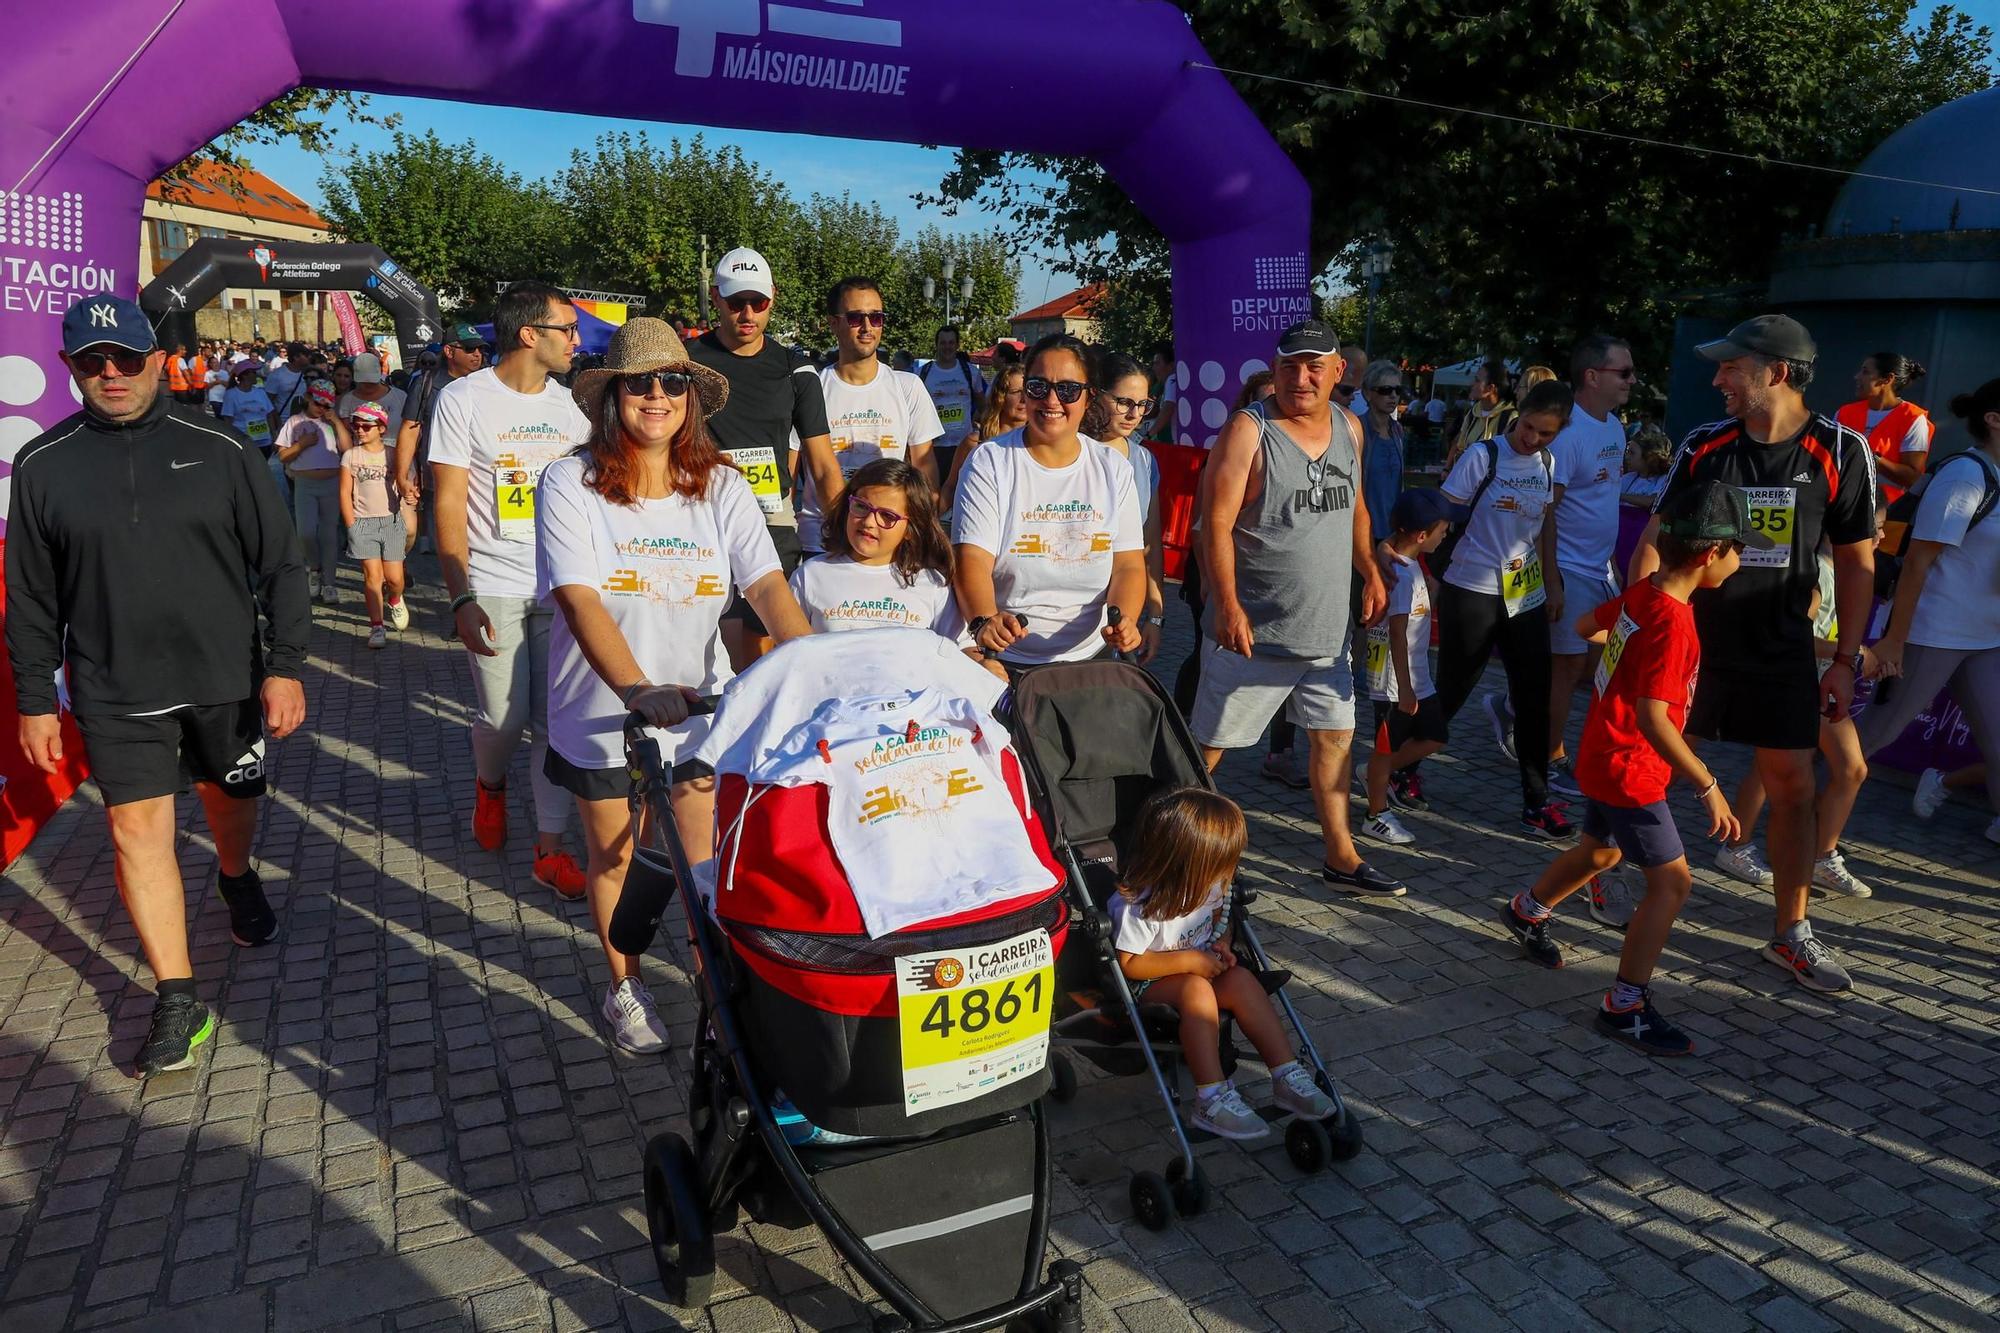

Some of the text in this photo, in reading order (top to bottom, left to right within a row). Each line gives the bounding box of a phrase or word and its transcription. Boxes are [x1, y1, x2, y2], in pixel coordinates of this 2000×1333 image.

[722, 43, 911, 97] MÁISIGUALDADE
[271, 260, 341, 274] Federación Galega
[732, 262, 759, 273] FILA
[282, 270, 321, 278] Atletismo
[849, 410, 883, 420] CARREIRA
[511, 424, 560, 434] A CARREIRA
[738, 449, 773, 459] CARREIRA
[746, 464, 775, 485] 54
[1036, 502, 1093, 513] A CARREIRA
[631, 537, 698, 550] A CARREIRA
[841, 599, 907, 612] A CARREIRA
[874, 727, 949, 753] A CAREIRA
[969, 936, 1047, 970] I CARREIRA
[968, 950, 1047, 984] solidaria de Leo
[920, 972, 1042, 1039] 4861
